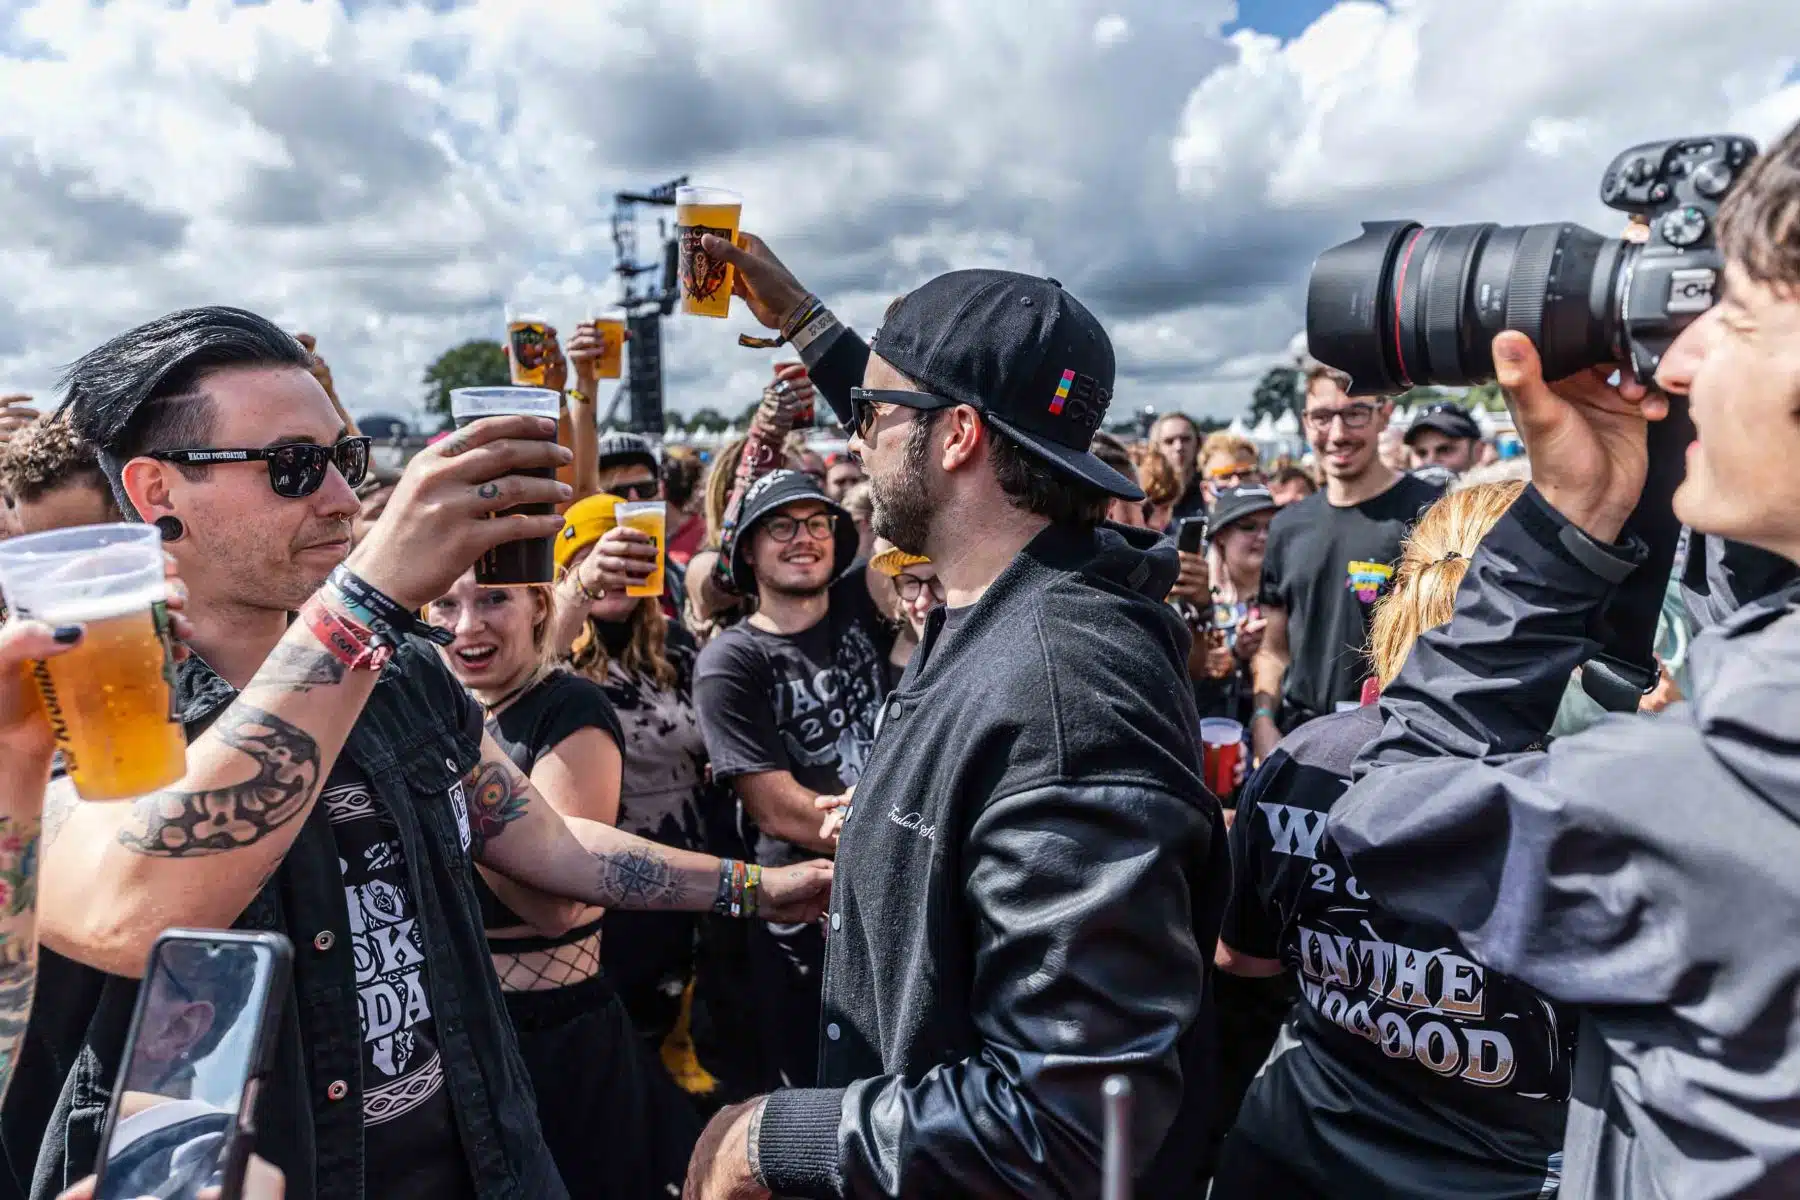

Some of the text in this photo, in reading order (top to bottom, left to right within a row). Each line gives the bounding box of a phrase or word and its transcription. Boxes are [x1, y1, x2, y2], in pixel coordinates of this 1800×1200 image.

[188, 450, 247, 461] WACKEN FOUNDATION
[1358, 939, 1485, 1020] THE
